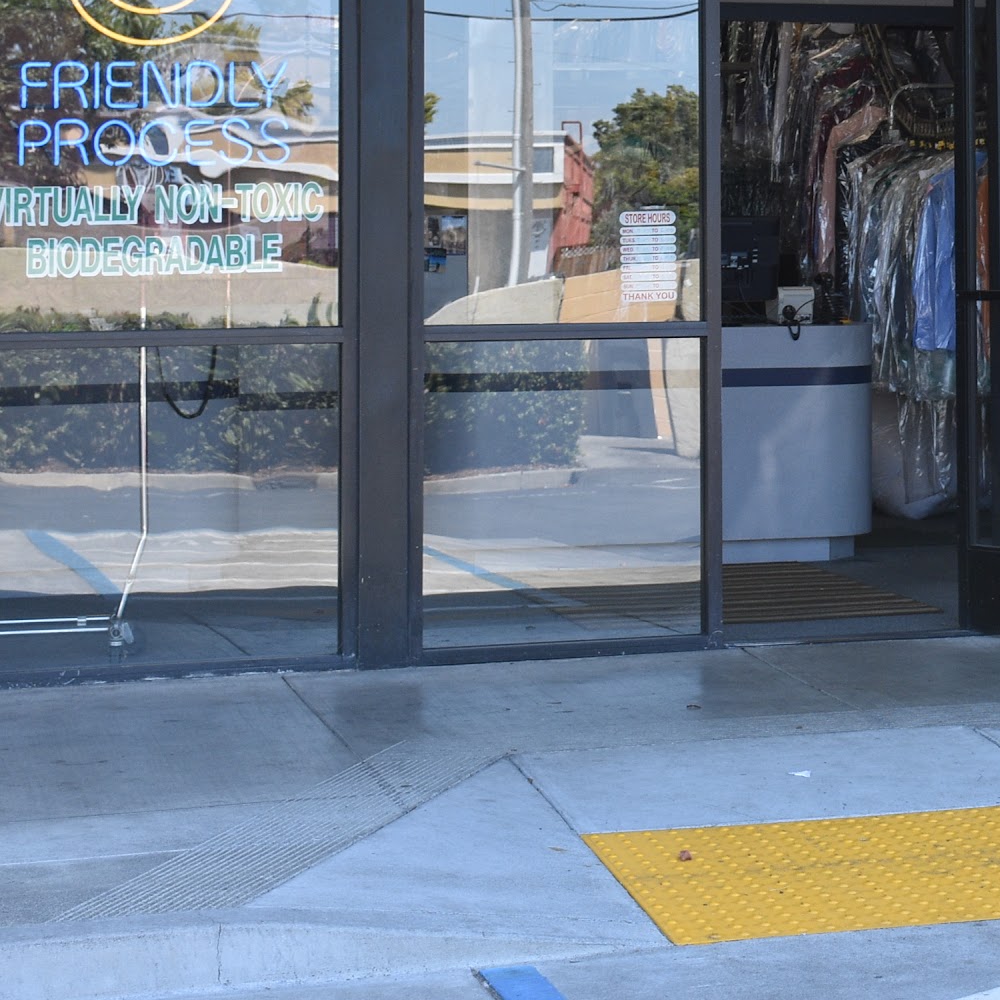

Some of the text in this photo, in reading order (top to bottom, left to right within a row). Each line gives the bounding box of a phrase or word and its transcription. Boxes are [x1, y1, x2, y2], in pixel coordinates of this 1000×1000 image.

[19, 60, 288, 110] FRIENDLY
[17, 118, 291, 167] PROCESS
[0, 181, 324, 227] IRTUALLY NON-TOXIC
[625, 213, 671, 223] STORE HOURS
[26, 232, 283, 278] BIODEGRADABLE
[623, 291, 675, 301] THANK YOU
